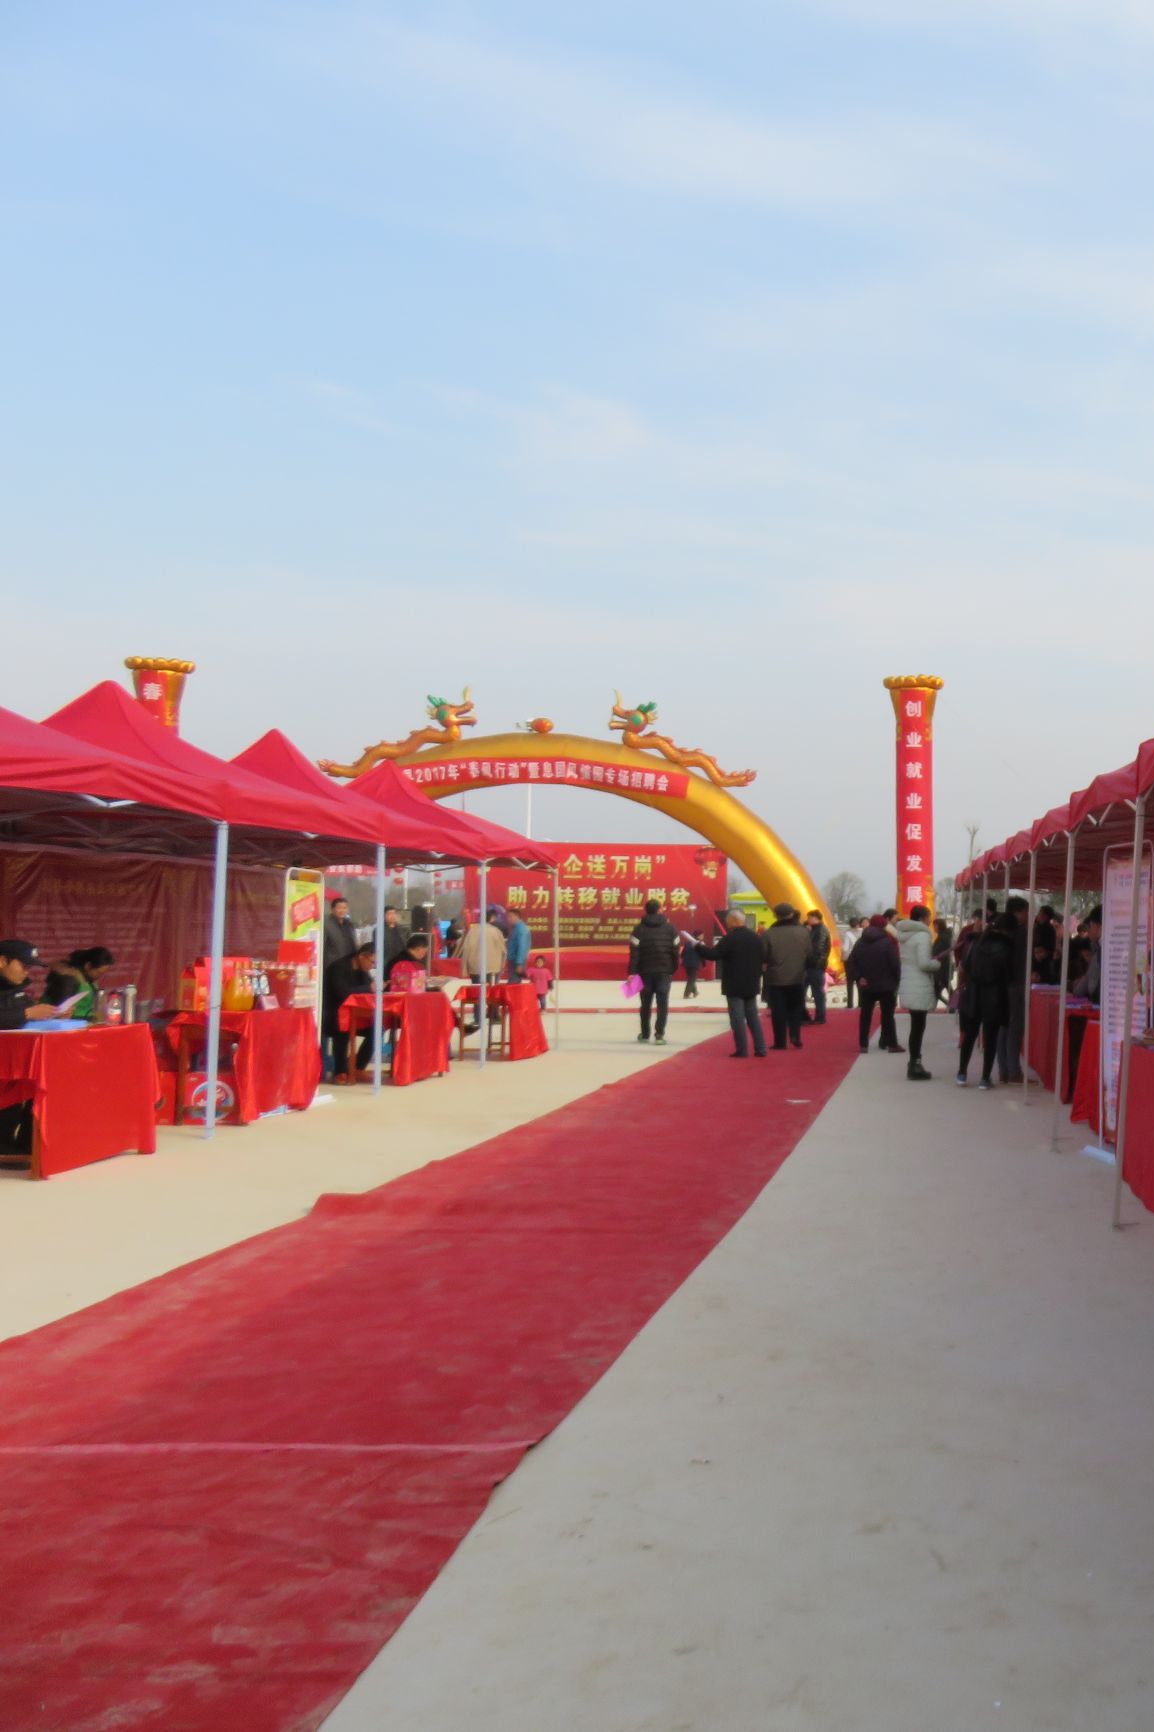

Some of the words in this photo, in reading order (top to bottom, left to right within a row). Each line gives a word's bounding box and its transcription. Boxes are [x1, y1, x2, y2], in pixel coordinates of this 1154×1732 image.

[905, 700, 923, 903] 创业就业促发展
[556, 854, 667, 880] 企送万岗”
[507, 886, 691, 912] 助力转移就业脱贫
